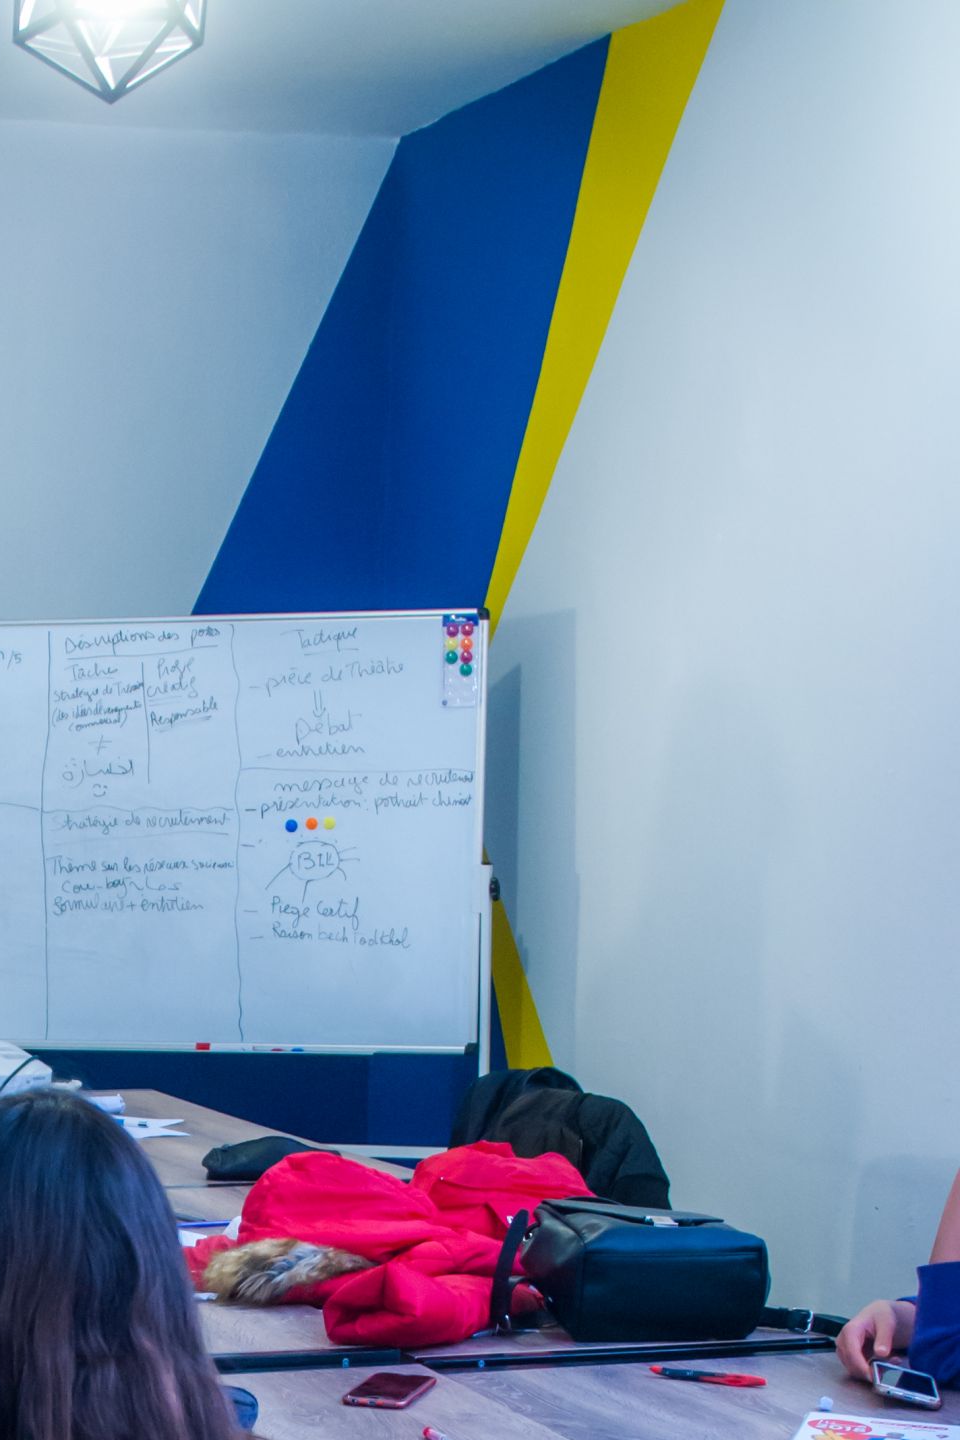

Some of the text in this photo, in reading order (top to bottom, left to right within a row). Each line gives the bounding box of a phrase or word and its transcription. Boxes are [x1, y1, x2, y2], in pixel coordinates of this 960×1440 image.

[158, 629, 180, 642] des
[321, 665, 342, 682] de
[379, 771, 398, 786] de
